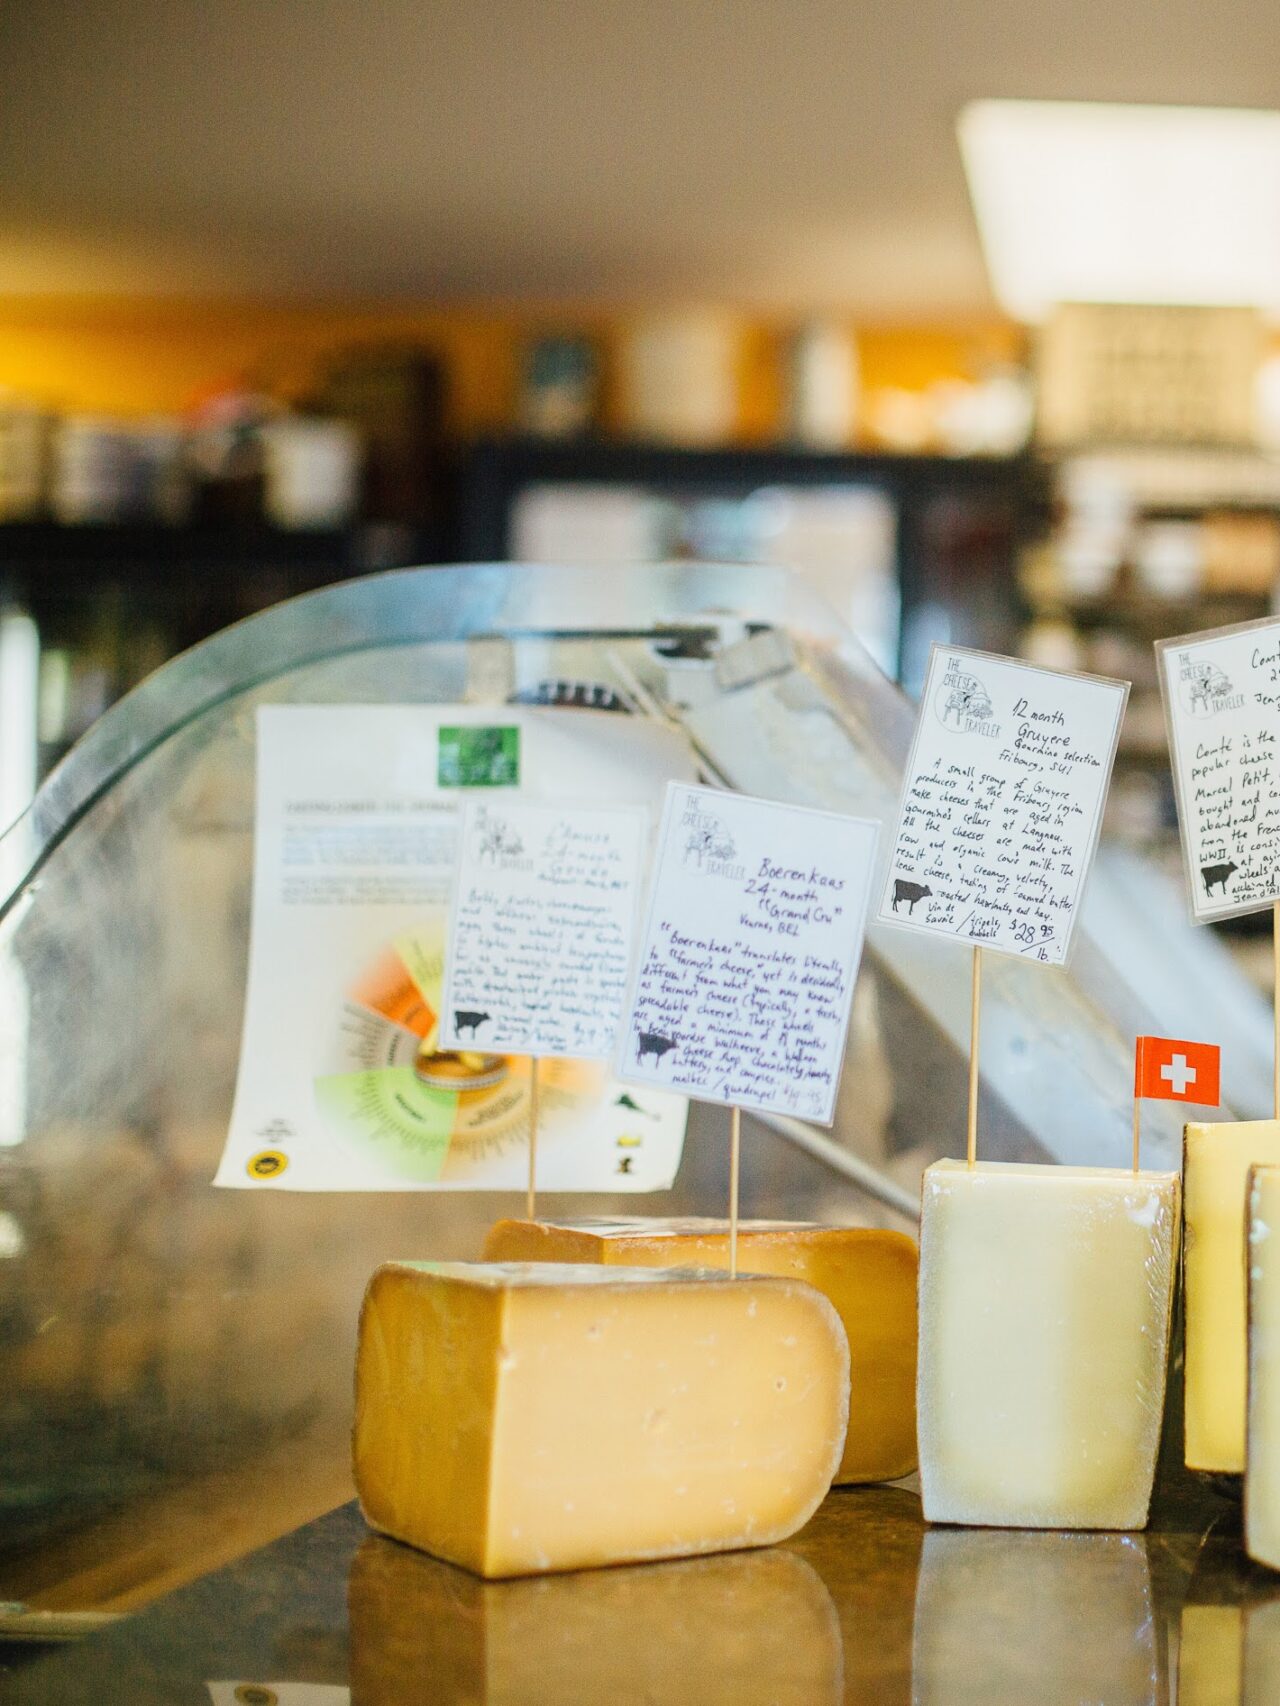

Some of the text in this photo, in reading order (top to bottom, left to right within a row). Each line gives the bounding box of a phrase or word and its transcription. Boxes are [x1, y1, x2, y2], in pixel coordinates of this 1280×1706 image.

[947, 657, 960, 672] THE
[1178, 652, 1190, 665] THE
[942, 673, 972, 691] CHEESE
[1012, 697, 1064, 726] 12 month
[1211, 693, 1244, 712] TRAVELER
[964, 717, 1001, 737] TRAVELER
[1015, 722, 1070, 747] Gruyere
[1242, 734, 1251, 747] is
[1257, 730, 1275, 743] the
[1063, 751, 1100, 766] selection
[1191, 757, 1229, 779] popular
[1239, 751, 1273, 765] cheese
[947, 765, 975, 777] small
[978, 773, 1005, 789] group
[1013, 777, 1027, 789] of
[915, 773, 957, 788] producers
[967, 780, 973, 792] in
[986, 785, 1002, 798] the
[1056, 802, 1082, 817] region
[1194, 776, 1232, 801] Marcel
[911, 788, 1063, 826] make cheeses that are aged in
[1198, 796, 1233, 818] bought
[1241, 790, 1260, 806] and
[963, 812, 1015, 830] cellars at
[1200, 815, 1256, 832] abandoned
[902, 815, 1072, 856] All the cheeses are made with
[1231, 829, 1247, 840] the
[1236, 840, 1244, 853] is
[896, 847, 925, 861] result
[934, 854, 943, 866] is
[929, 841, 945, 850] and
[952, 844, 984, 858] organic
[1060, 863, 1073, 876] The
[1240, 854, 1252, 865] at
[959, 876, 986, 893] tasting
[996, 883, 1010, 893] of
[1016, 907, 1030, 915] and
